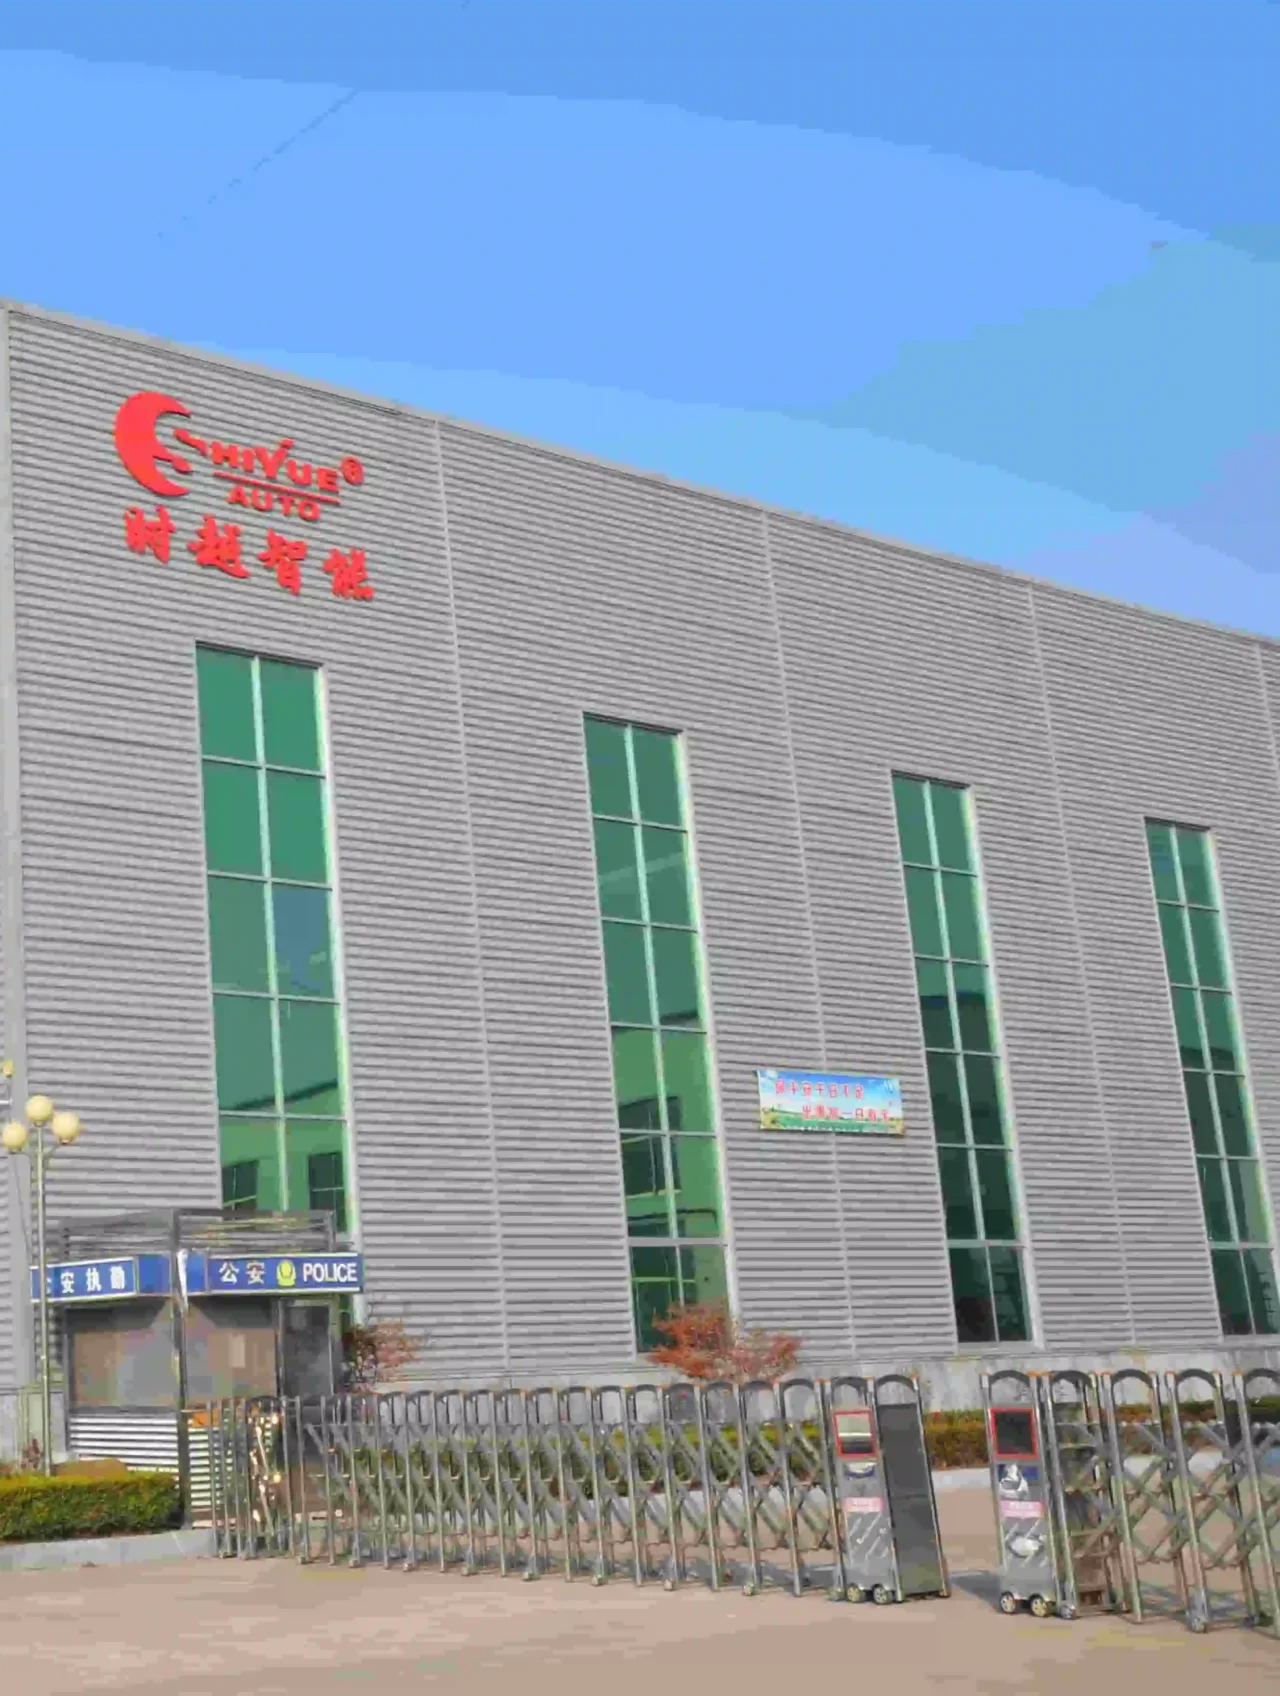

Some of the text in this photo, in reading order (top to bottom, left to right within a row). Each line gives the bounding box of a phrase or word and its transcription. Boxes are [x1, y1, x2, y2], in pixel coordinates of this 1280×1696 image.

[227, 484, 321, 522] AUTO
[46, 1265, 126, 1294] 安执勤
[218, 1260, 359, 1285] 公安 POLICE
